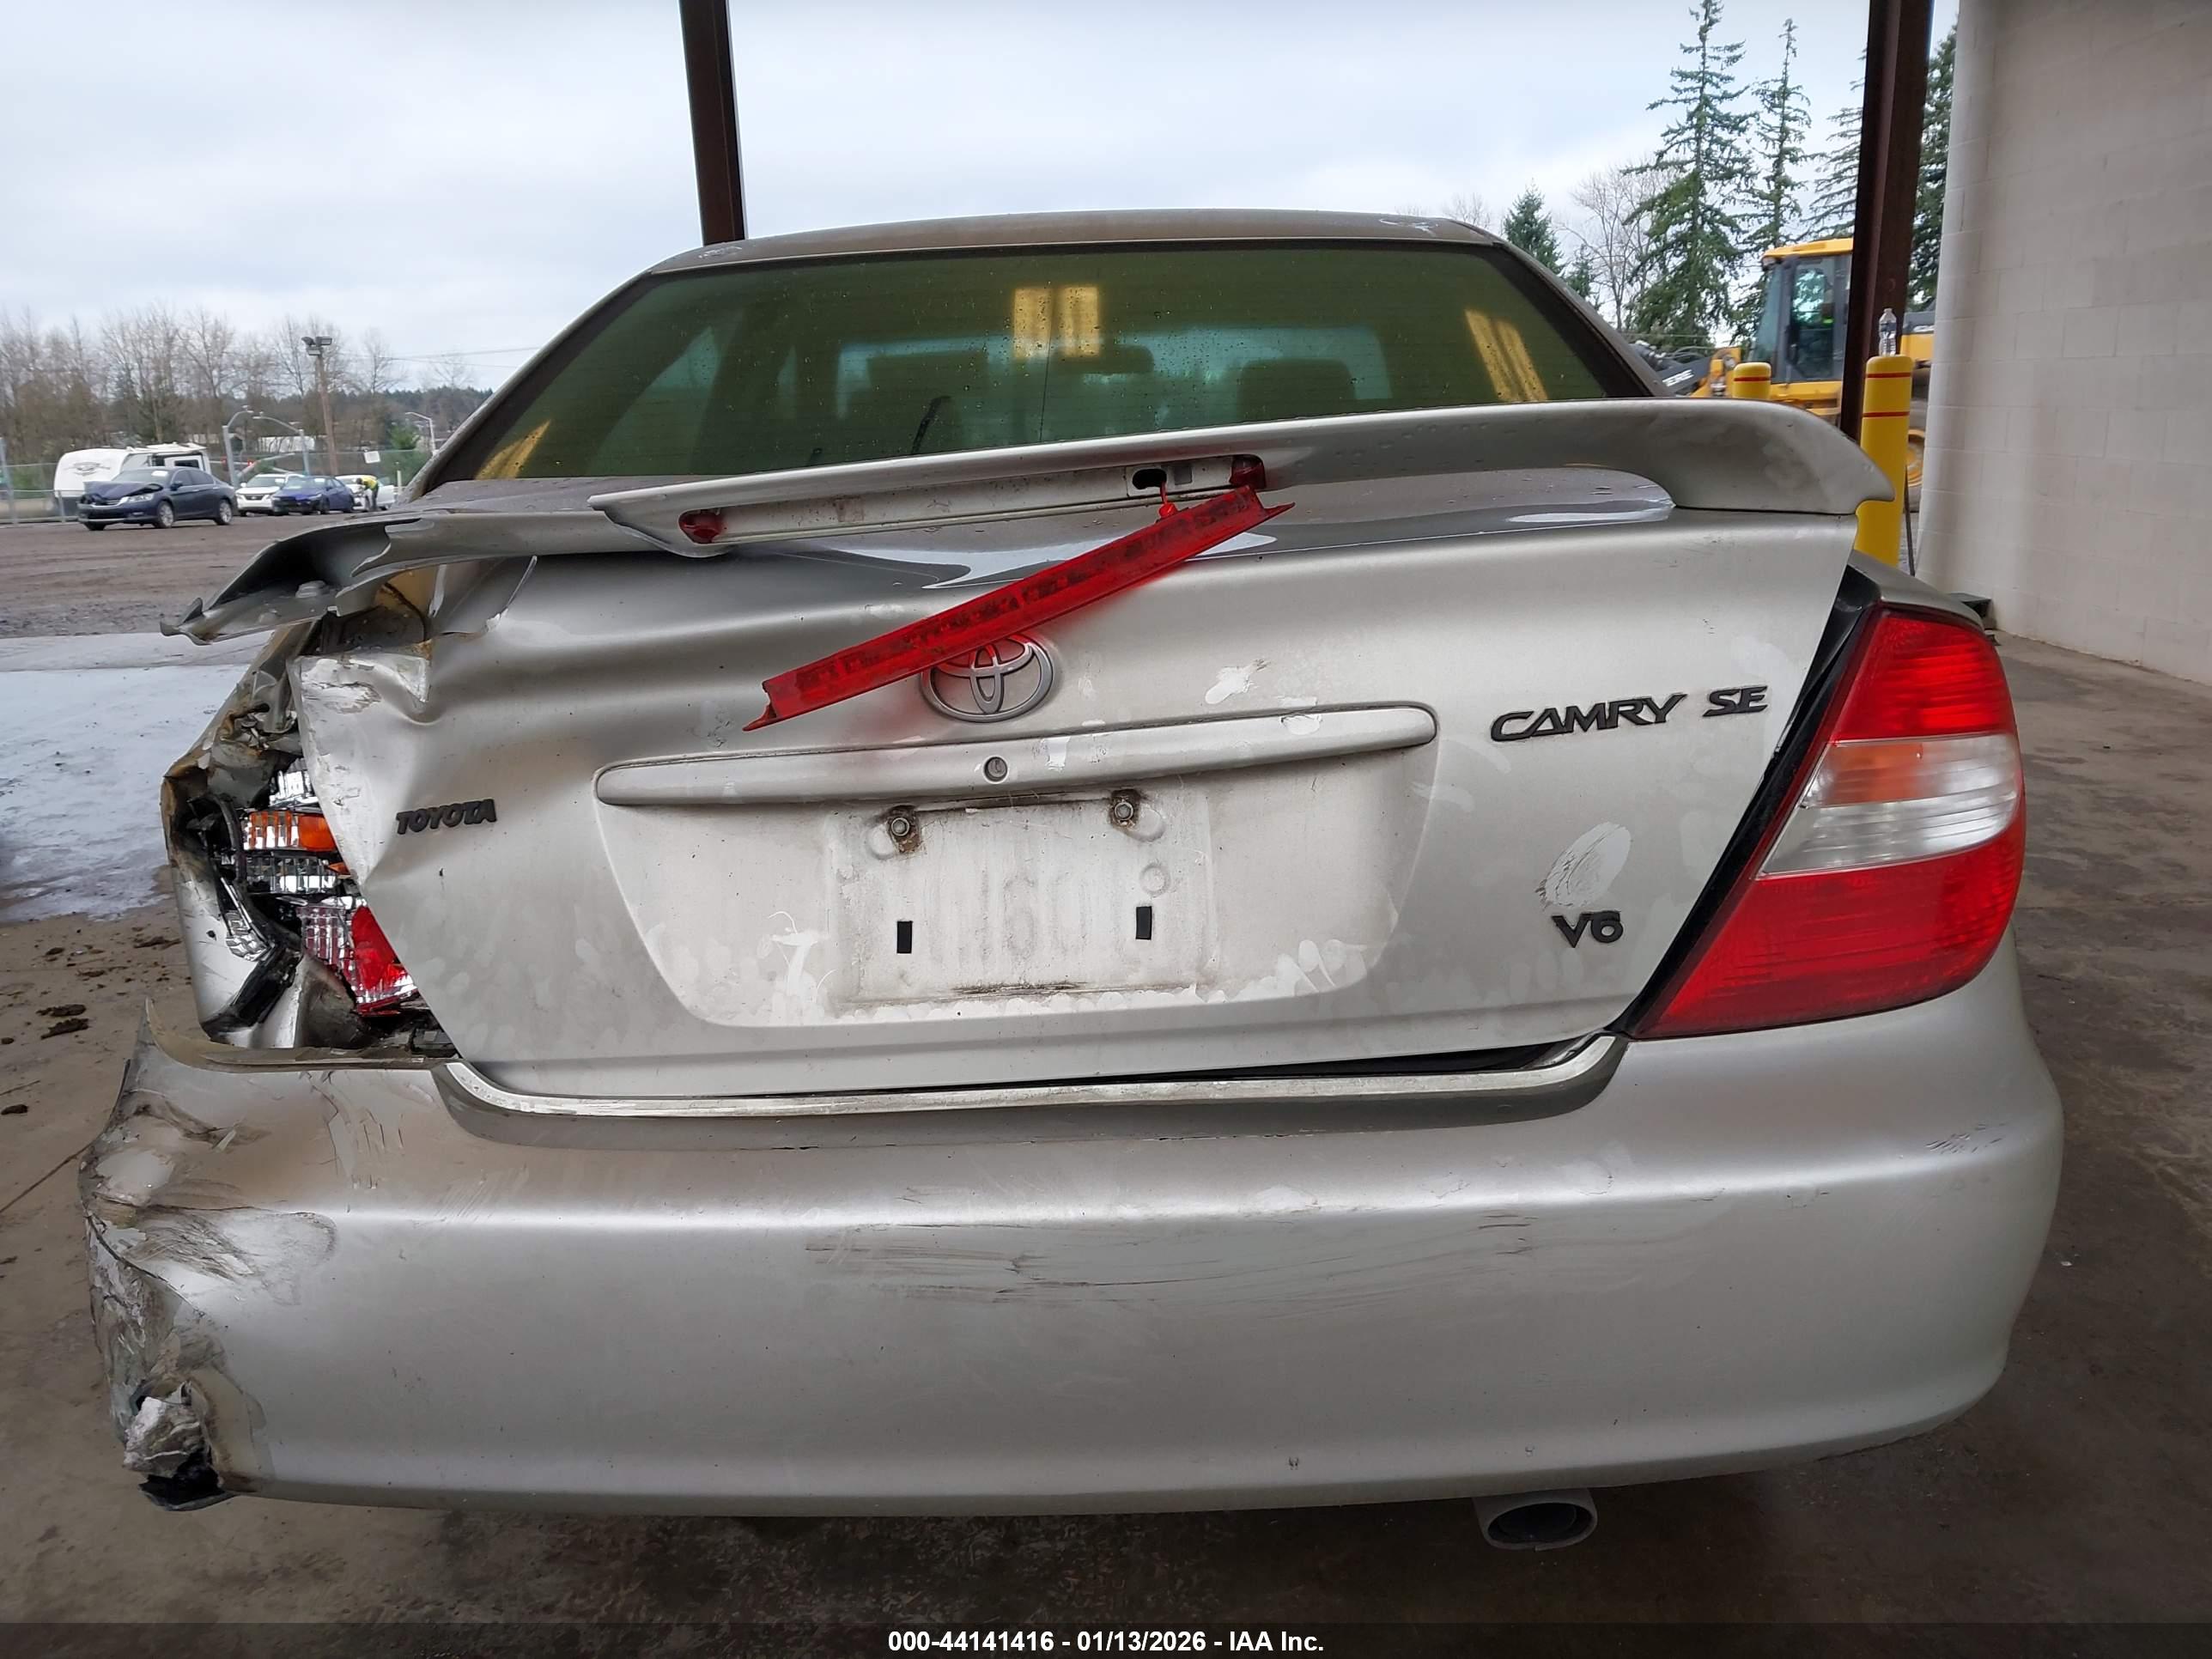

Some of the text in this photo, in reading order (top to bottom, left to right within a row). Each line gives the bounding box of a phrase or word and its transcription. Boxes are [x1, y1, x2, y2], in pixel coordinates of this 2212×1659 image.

[1491, 685, 1768, 742] CAMRY SE
[396, 798, 497, 835] TOYOTA
[1551, 910, 1623, 948] V6
